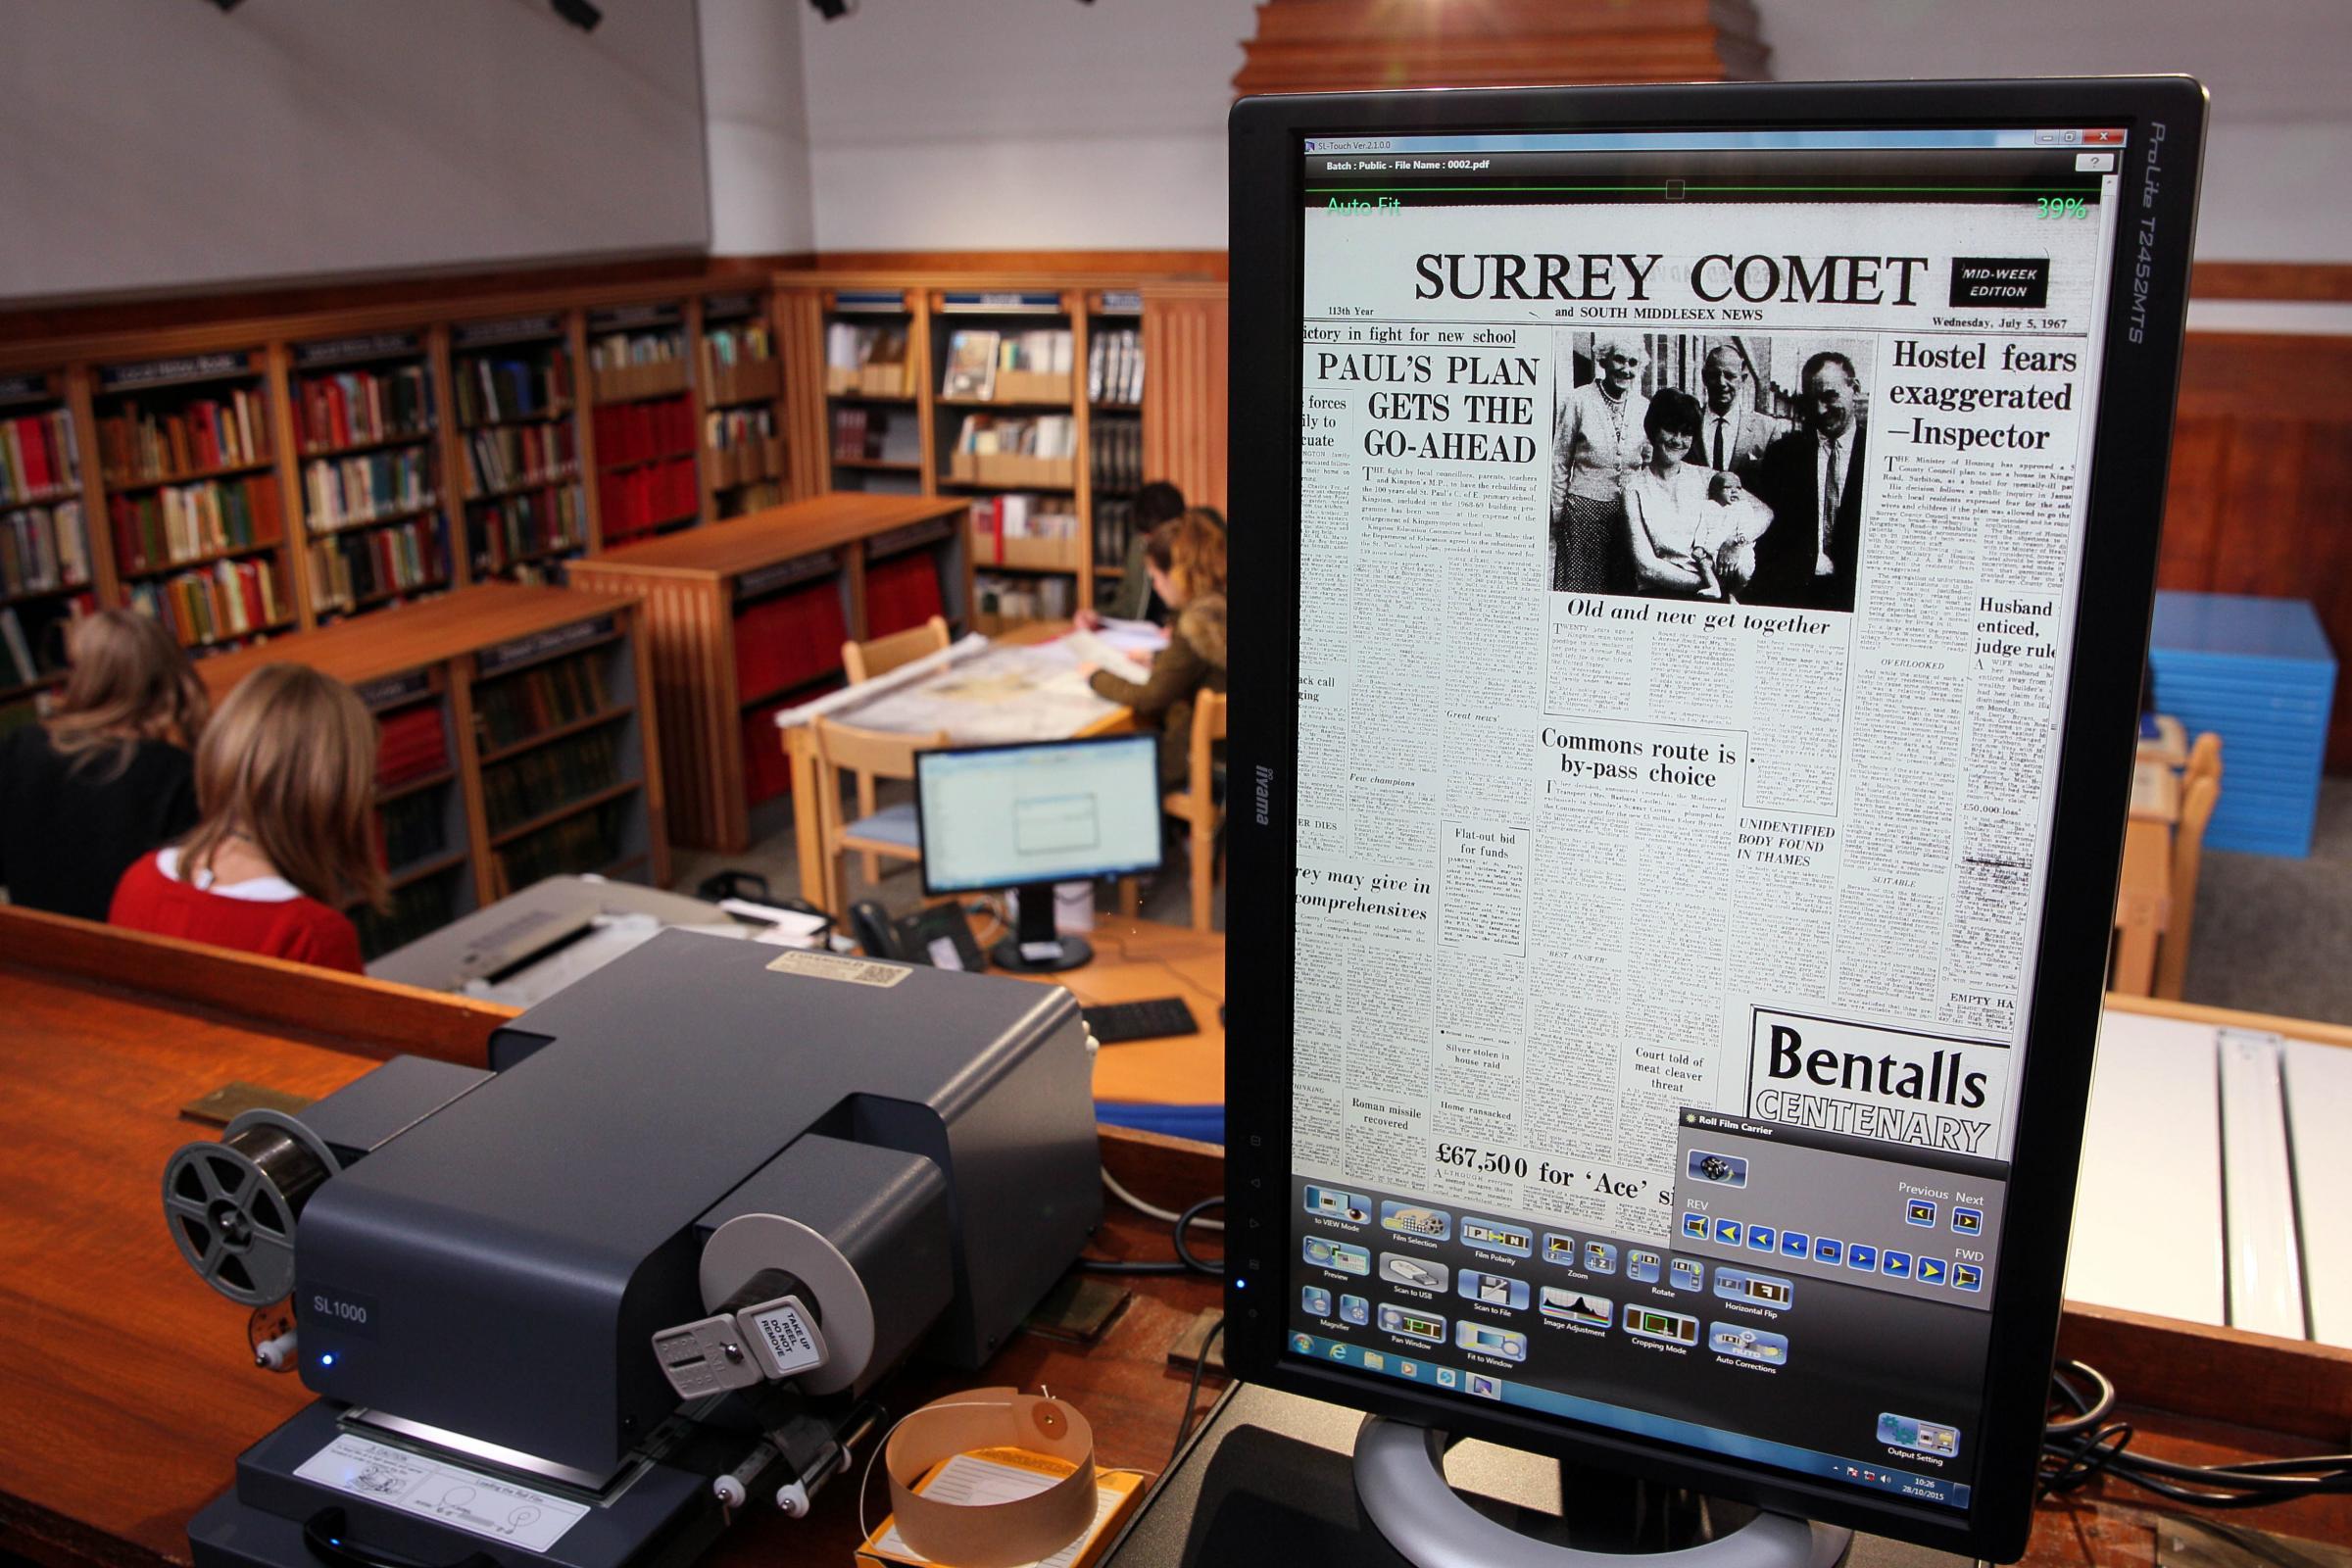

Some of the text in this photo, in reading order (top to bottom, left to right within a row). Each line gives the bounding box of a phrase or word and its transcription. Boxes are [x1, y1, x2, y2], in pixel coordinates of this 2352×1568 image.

[1327, 161, 1353, 170] Batch
[1358, 161, 1386, 170] Public
[1395, 161, 1410, 170] File
[1447, 159, 1490, 170] 0002.pdf
[1327, 198, 1400, 216] Auto Fit
[2035, 198, 2086, 219] 39%
[2129, 122, 2166, 344] ProLite T2452MTS
[1415, 253, 1929, 307] SURREY COMET
[1962, 268, 2036, 280] MID-WEEK
[1970, 285, 2027, 297] EDITION
[1328, 306, 1374, 317] 113th Year
[1555, 306, 1763, 320] and SOUTH MIDDLESEX NEWS
[1933, 317, 2067, 330] Wednesday, July 5, 1967
[1349, 327, 1361, 341] in
[1369, 327, 1401, 344] fight
[1409, 328, 1430, 342] for
[1438, 331, 1464, 343] new
[1473, 329, 1516, 344] school
[1892, 340, 2077, 372] Hostel fears
[1318, 354, 1540, 385] PAUL'S PLAN
[1309, 396, 1347, 410] forces
[1889, 383, 2072, 412] exaggerated
[1368, 392, 1533, 425] GETS THE
[1324, 416, 1336, 427] to
[1364, 429, 1536, 464] GO-AHEAD
[1980, 597, 2052, 616] Husband
[1567, 599, 1831, 636] Old and new get together
[1978, 620, 2038, 637] enticed,
[1975, 638, 2021, 658] judge
[1881, 659, 1944, 670] OVERLOOKED
[1317, 677, 1335, 686] call
[1542, 727, 1736, 764] Commons route is
[1349, 773, 1415, 787] Few champions
[1561, 755, 1716, 788] by-pass choice
[1256, 764, 1273, 825] iiyama
[1315, 820, 1337, 830] DIES
[1740, 818, 1835, 839] UNIDENTIFIED
[1455, 828, 1515, 845] Flat-out bid
[1739, 833, 1824, 854] BODY FOUND
[1460, 845, 1509, 858] for funds
[1738, 848, 1811, 867] IN THAMES
[1328, 871, 1364, 891] may
[1371, 873, 1407, 893] give
[1413, 878, 1431, 894] in
[1873, 876, 1916, 888] SUITABLE
[1950, 994, 1990, 1005] EMPTY
[1446, 1044, 1469, 1055] Silver
[1474, 1048, 1498, 1058] stolen
[1636, 1047, 1704, 1067] Court told of
[1455, 1055, 1500, 1070] house raid
[1768, 1025, 1987, 1108] Bentalls
[1635, 1063, 1702, 1082] meat cleaver
[1651, 1078, 1684, 1093] threat
[1352, 1098, 1421, 1119] Roman missile
[1441, 1101, 1511, 1120] Home ransacked
[1363, 1115, 1408, 1130] recovered
[1698, 1115, 1773, 1136] Roll Film Carrier
[1756, 1090, 1990, 1153] CENTENARY
[1435, 1143, 1528, 1178] £67,500
[1540, 1162, 1574, 1187] for
[1899, 1181, 1984, 1206] Previous Next
[1687, 1199, 1708, 1211] REV
[1323, 1219, 1341, 1229] VIEW
[1343, 1223, 1359, 1233] Mode
[1407, 1237, 1438, 1249] Selection
[1475, 1250, 1516, 1266] Film Polarity
[1955, 1249, 1984, 1262] FWD
[1324, 1270, 1348, 1281] Preview
[1568, 1269, 1588, 1280] Zoom
[1394, 1286, 1408, 1295] Scan
[1419, 1290, 1432, 1299] USB
[1652, 1287, 1675, 1298] Rotate
[315, 1296, 367, 1324] SL1000
[1474, 1303, 1490, 1313] Scan
[1499, 1308, 1511, 1317] File
[1726, 1302, 1778, 1320] Horizontal Flip
[788, 1313, 810, 1350] TAKE UP
[1320, 1319, 1349, 1331] Magnifier
[1544, 1318, 1605, 1337] Image Adjustment
[761, 1320, 785, 1356] REMOVE
[771, 1320, 792, 1352] DO NOT
[782, 1322, 798, 1346] REEL
[1392, 1335, 1431, 1350] Pan Window
[1632, 1338, 1687, 1355] Cropping Mode
[1486, 1356, 1513, 1369] Window
[1716, 1356, 1776, 1374] Auto Corrections
[1888, 1447, 1943, 1466] Output Setting
[1915, 1478, 1935, 1488] 10:26
[1902, 1486, 1944, 1500] 28/10/2015
